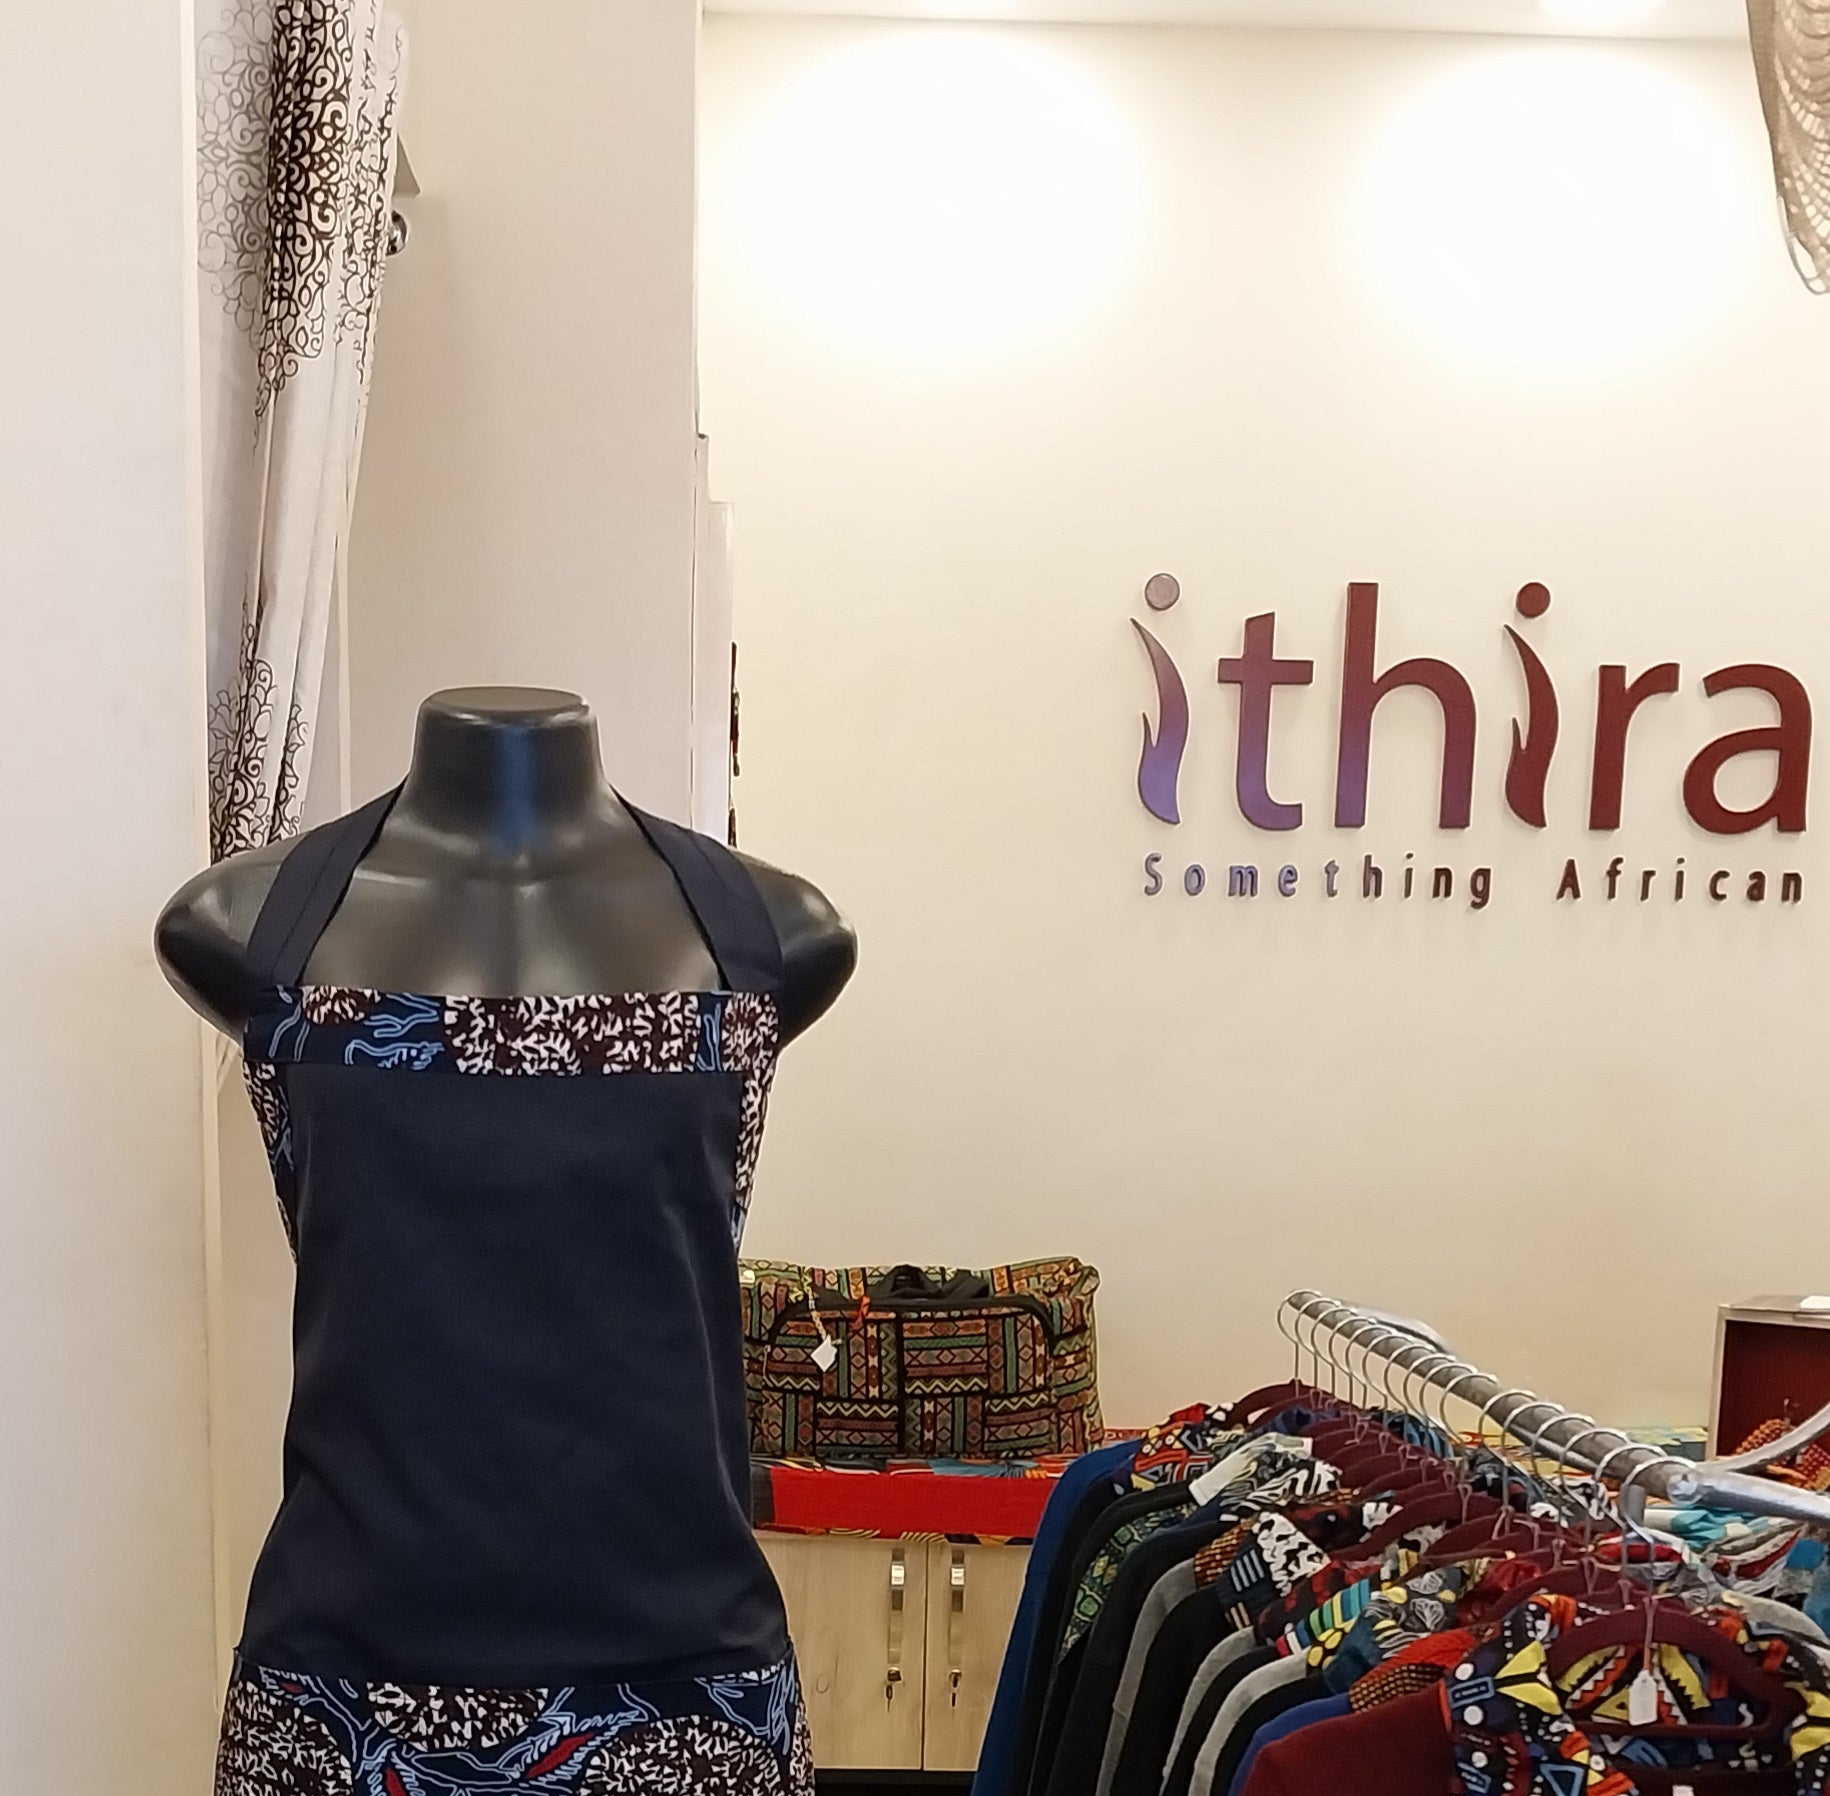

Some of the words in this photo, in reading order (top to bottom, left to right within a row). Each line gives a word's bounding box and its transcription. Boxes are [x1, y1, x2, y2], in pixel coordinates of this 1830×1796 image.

[1130, 573, 1813, 835] ithira
[1144, 852, 1493, 910] Something
[1556, 856, 1803, 902] African
